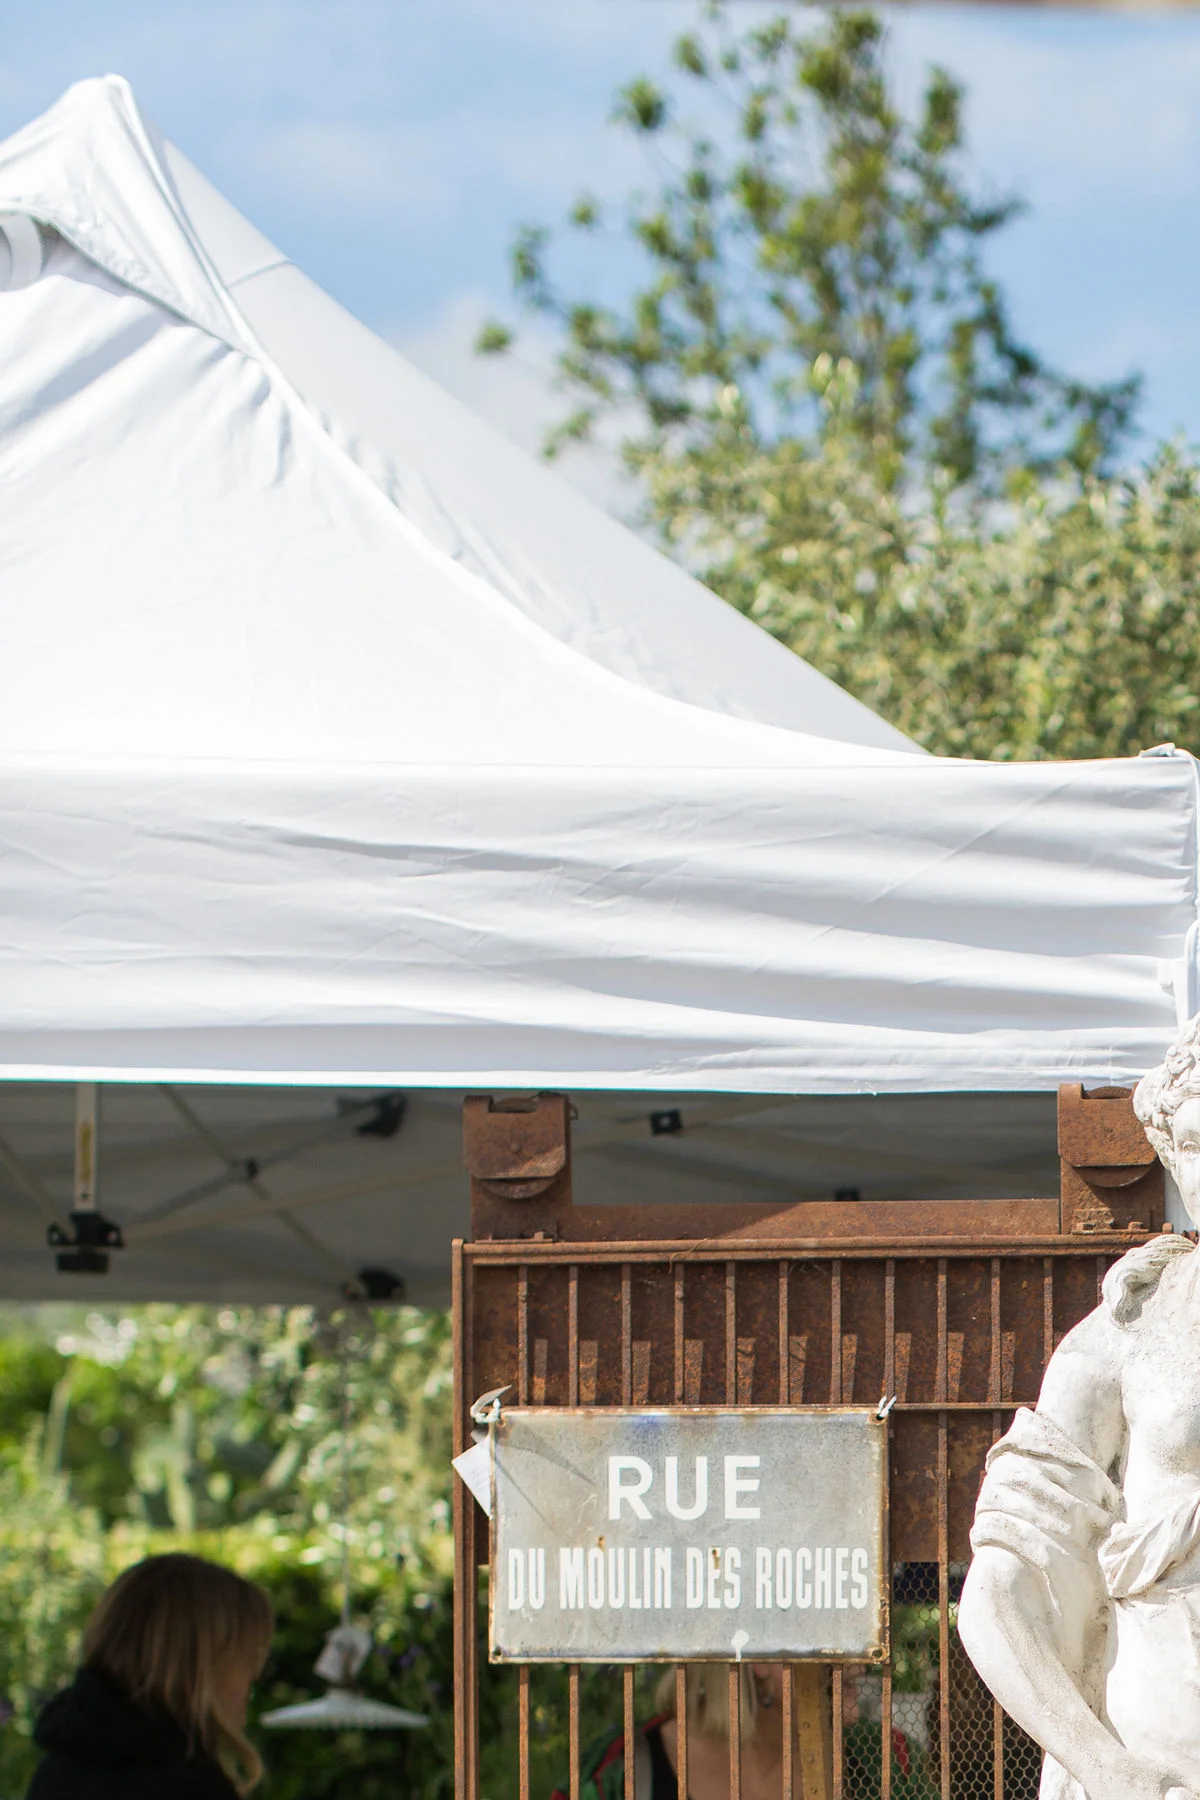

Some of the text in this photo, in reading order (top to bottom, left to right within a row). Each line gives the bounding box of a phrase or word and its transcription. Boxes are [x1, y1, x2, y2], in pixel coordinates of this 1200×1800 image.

[608, 1455, 761, 1520] RUE
[508, 1547, 869, 1610] DU MOULIN DES ROCHES
